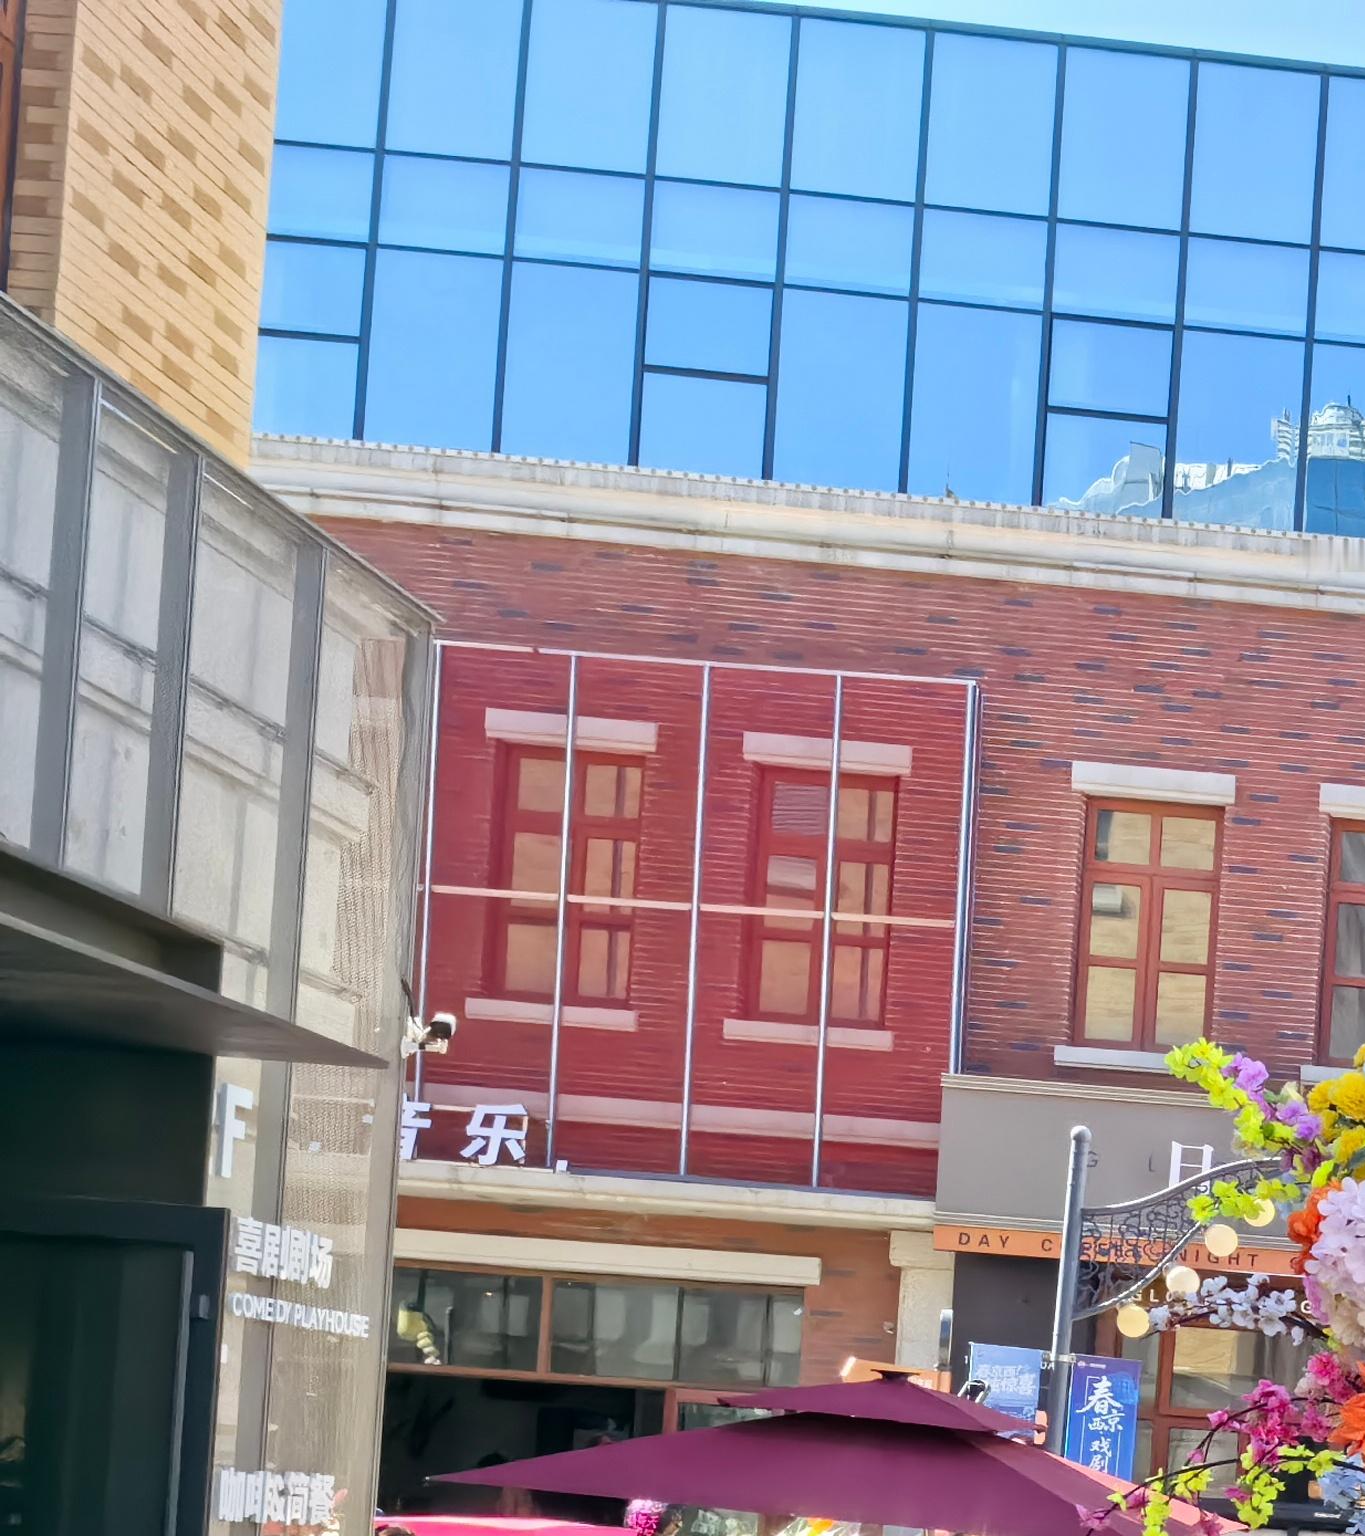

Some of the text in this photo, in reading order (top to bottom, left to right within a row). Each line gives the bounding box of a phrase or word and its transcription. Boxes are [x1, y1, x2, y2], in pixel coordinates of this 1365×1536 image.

[958, 1232, 1010, 1249] DAY
[232, 1292, 370, 1338] COMEDY PLAYHOUSE
